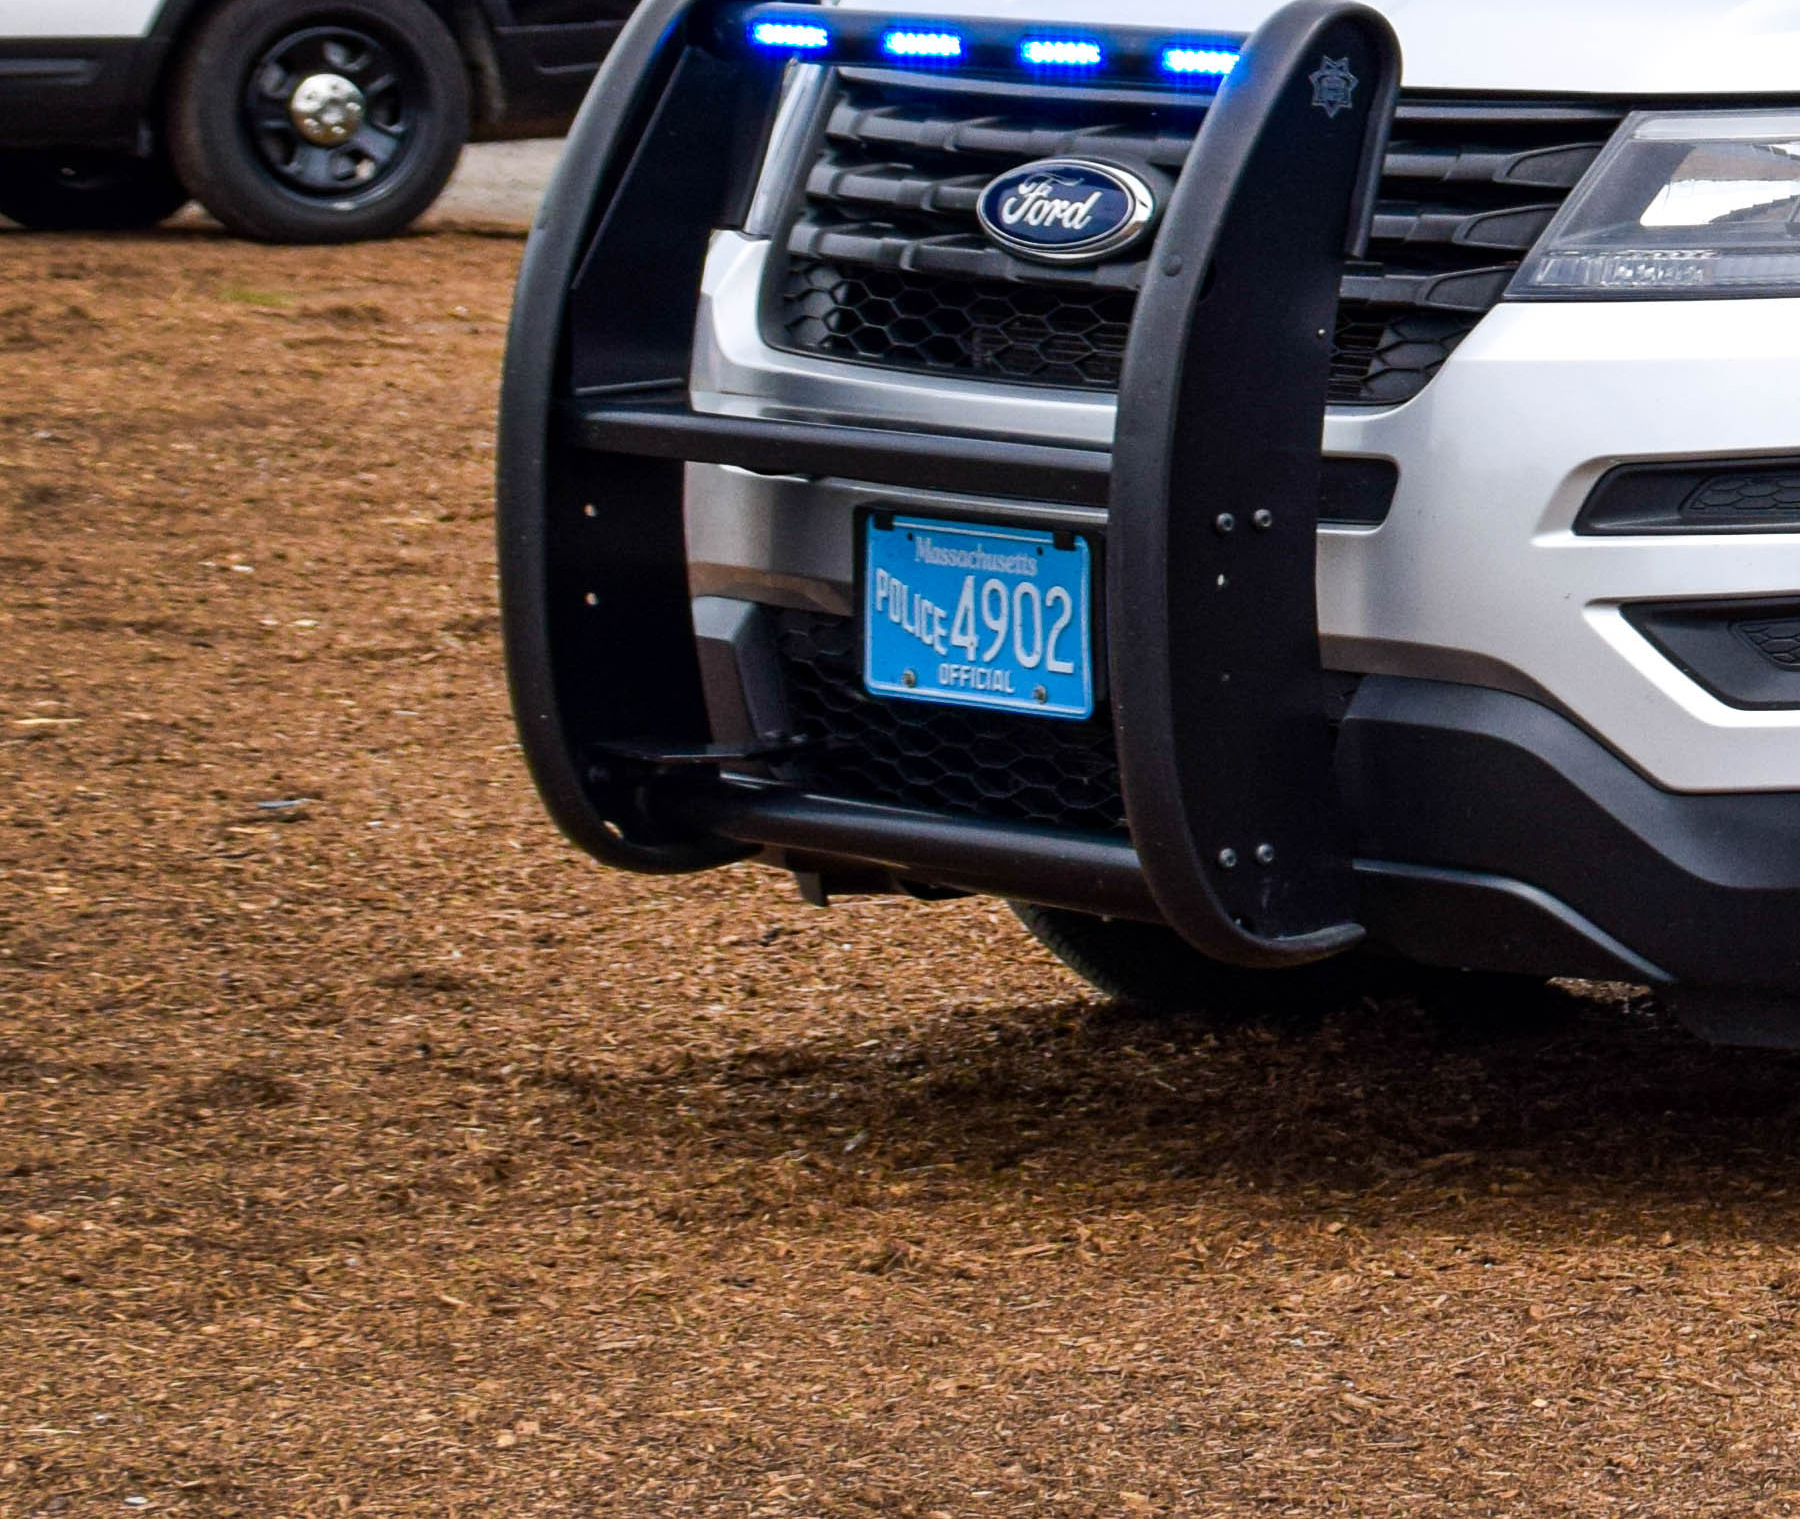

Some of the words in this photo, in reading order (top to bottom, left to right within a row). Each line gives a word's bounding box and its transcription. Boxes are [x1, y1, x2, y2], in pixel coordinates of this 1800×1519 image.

[1001, 171, 1104, 230] Ford
[914, 536, 1038, 577] Massachusetts
[875, 568, 948, 656] POLICE
[951, 575, 1075, 674] 4902
[938, 663, 1015, 693] OFFICIAL
